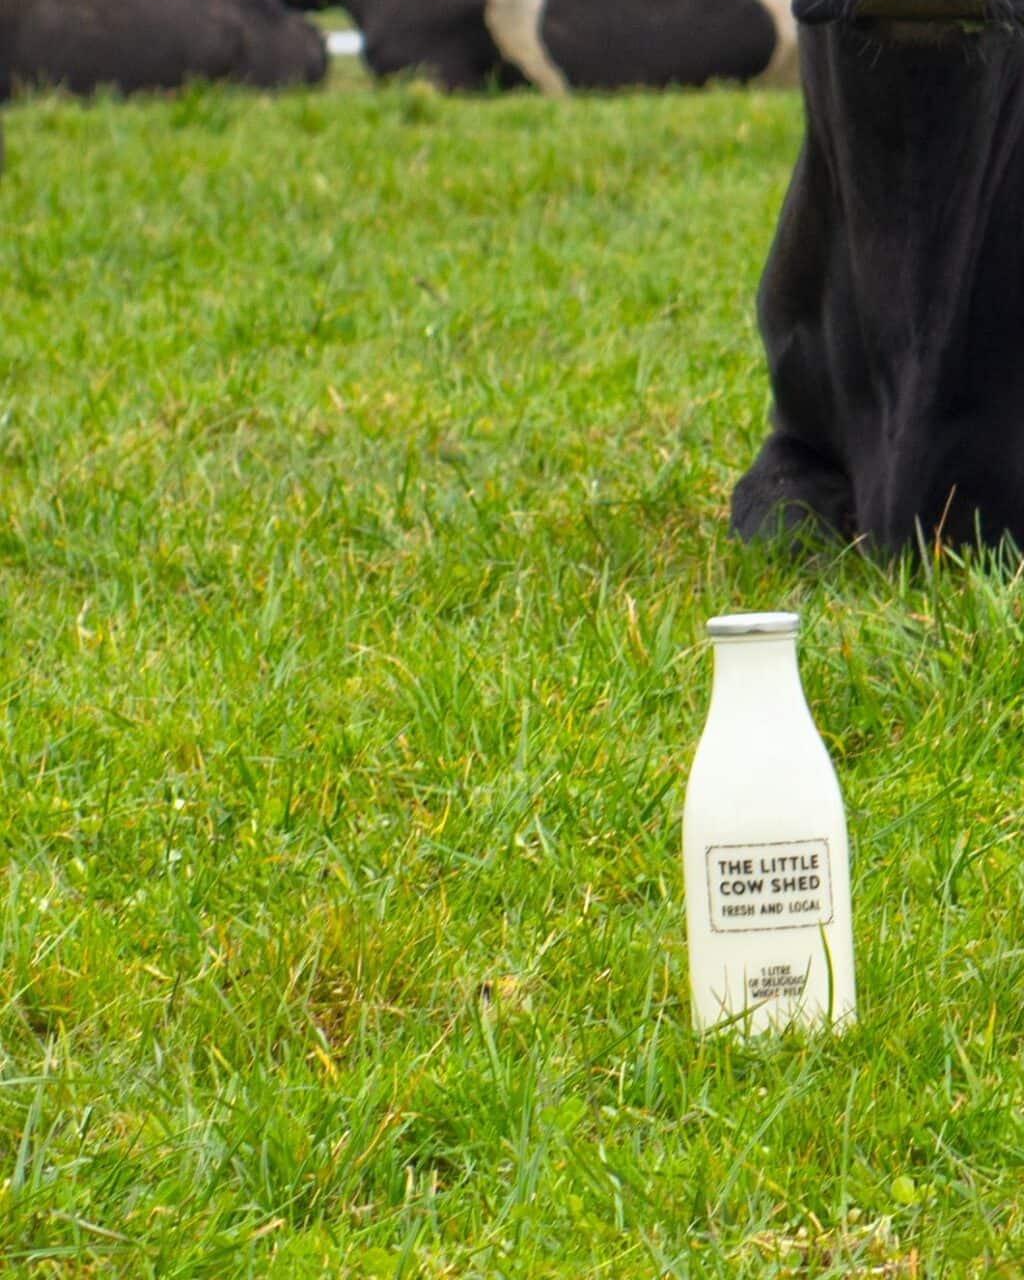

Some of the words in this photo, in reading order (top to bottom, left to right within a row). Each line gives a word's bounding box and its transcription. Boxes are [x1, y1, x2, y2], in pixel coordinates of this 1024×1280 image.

[718, 859, 753, 875] THE
[760, 854, 819, 873] LITTLE
[719, 879, 764, 896] COW
[770, 875, 821, 893] SHED
[721, 904, 756, 917] FRESH
[759, 902, 784, 915] AND
[788, 899, 821, 914] LOCAL
[768, 965, 791, 976] LITRE
